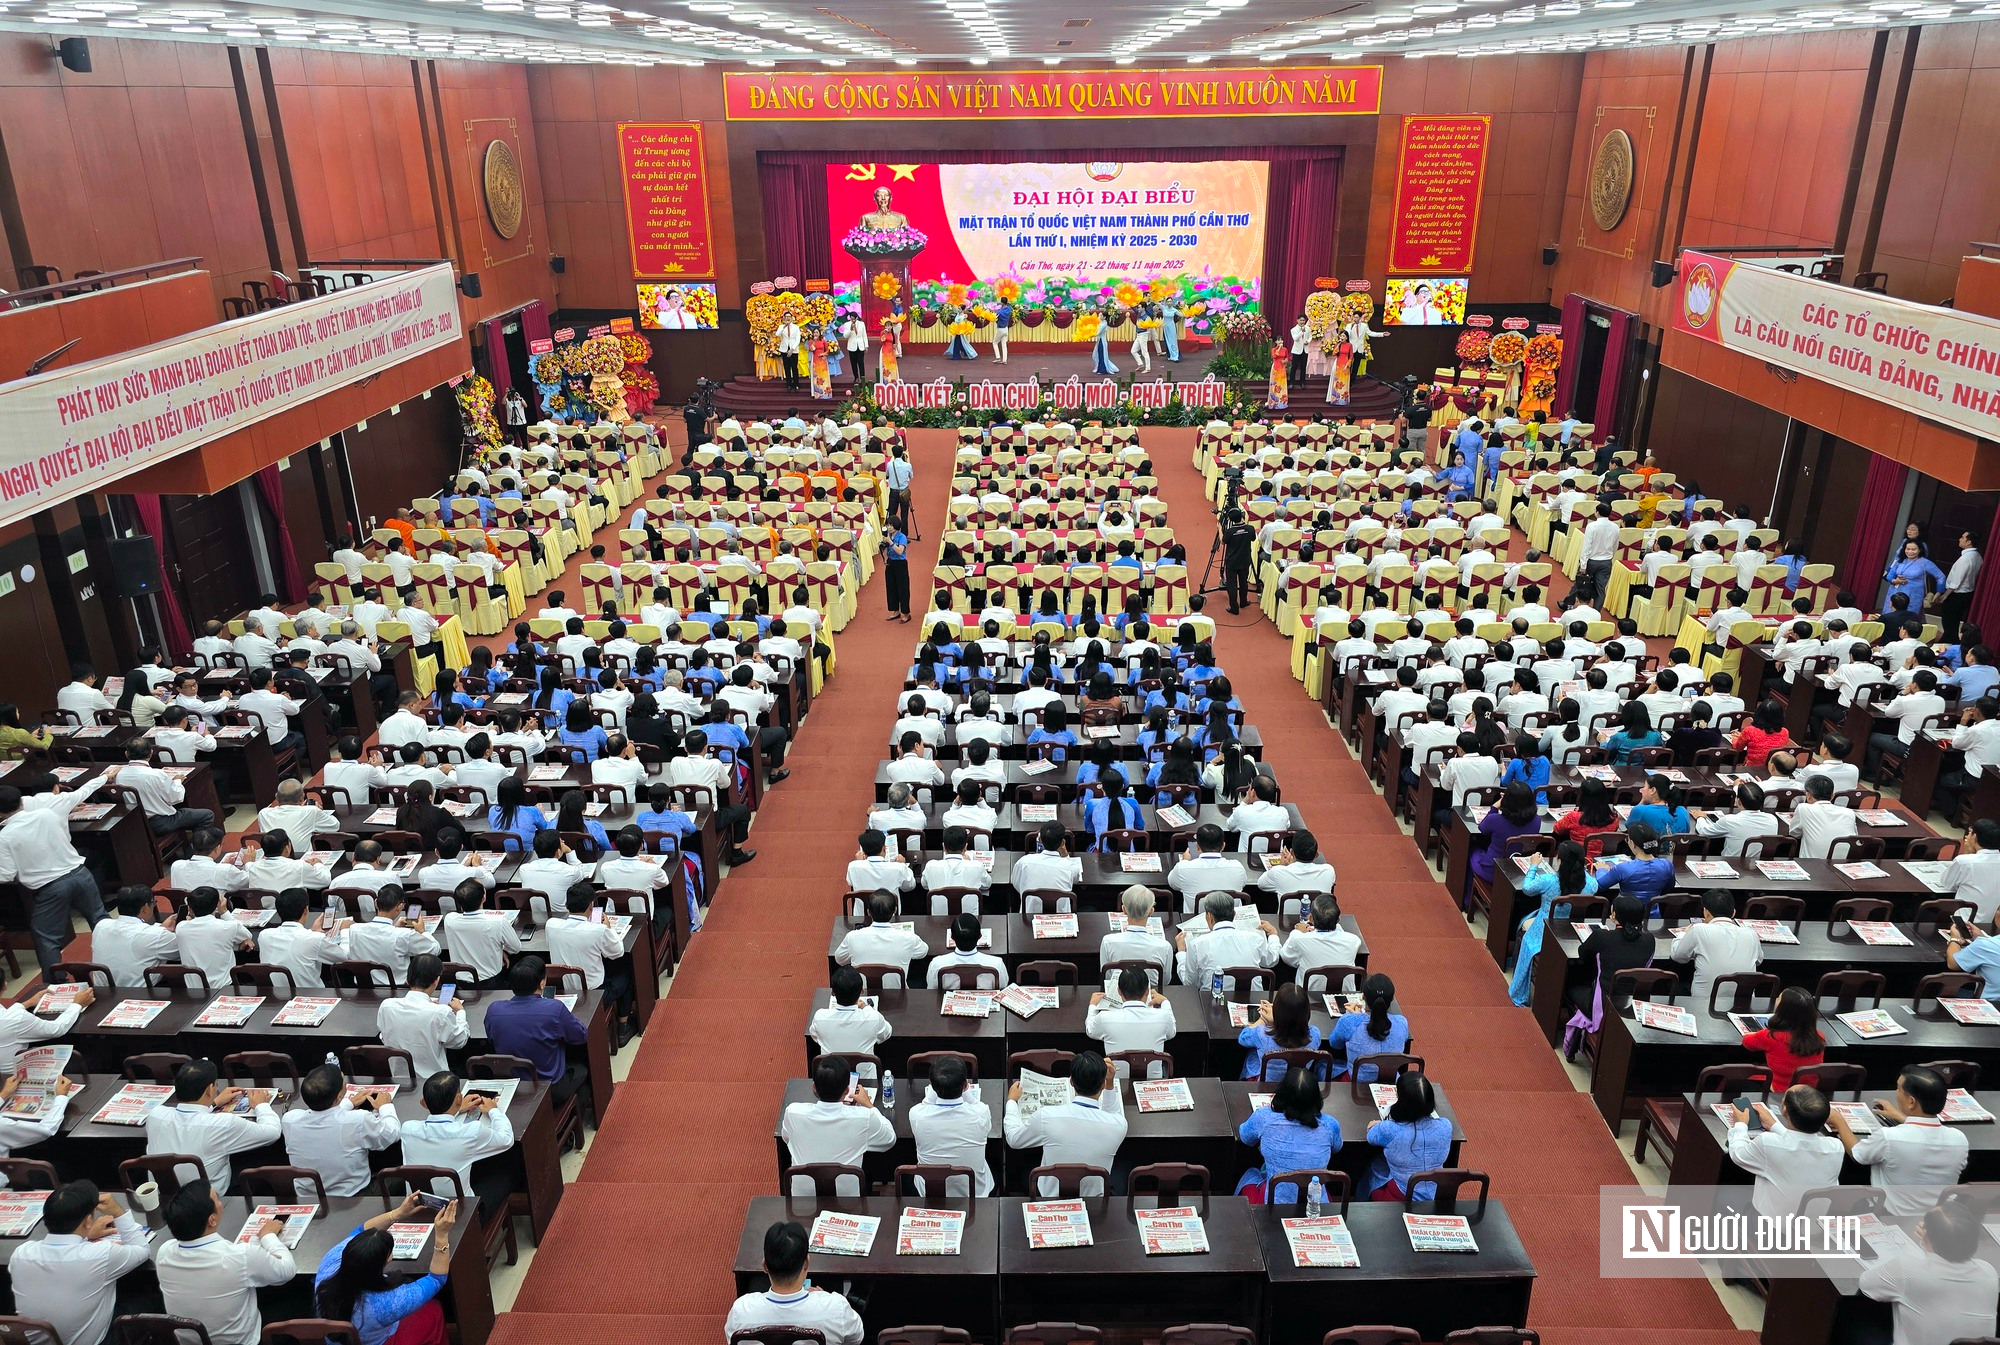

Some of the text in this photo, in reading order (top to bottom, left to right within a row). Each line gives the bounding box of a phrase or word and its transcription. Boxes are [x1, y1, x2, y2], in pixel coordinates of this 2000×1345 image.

[749, 73, 1357, 114] ĐẢNG CỘNG SẢN VIỆT NAM QUANG VINH MUÔN NĂM
[641, 134, 693, 144] Các đồng chí
[634, 147, 690, 156] từ Trung ương
[634, 159, 650, 167] đến
[667, 159, 680, 167] chi
[682, 159, 692, 168] bộ
[632, 171, 696, 181] cần phải giữ gìn
[676, 183, 688, 191] kết
[651, 195, 670, 203] nhất
[1013, 181, 1195, 208] ĐẠI HỘI ĐẠI BIỂU
[649, 207, 686, 216] của Đảng
[646, 219, 692, 228] như giữ gìn
[959, 211, 1250, 231] MẶT TRẬN TỔ QUỐC VIỆT NAM THÀNH PHỐ CẦN THƠ
[640, 242, 654, 250] của
[656, 242, 672, 250] mắt
[1009, 232, 1031, 248] LẦN
[1034, 234, 1058, 247] THỨ
[1060, 236, 1067, 248] I,
[1070, 233, 1108, 249] NHIỆM
[1112, 232, 1127, 246] KỲ
[1130, 235, 1158, 246] 2025
[1169, 234, 1198, 246] 2030
[1020, 260, 1036, 270] Cần
[1038, 261, 1054, 271] Thơ,
[1056, 262, 1075, 272] ngày
[1076, 261, 1088, 270] 21
[1094, 261, 1106, 270] 22
[1107, 260, 1130, 270] tháng
[1132, 261, 1142, 269] 11
[1162, 260, 1185, 269] 2025
[1802, 303, 1838, 330] CÁC
[1845, 310, 1871, 337] TỔ
[1873, 322, 1930, 355] CHỨC
[57, 287, 423, 426] PHÁT HUY SỨC MẠNH ĐẠI ĐOÀN KẾT TOÀN DÂN TỘC, QUYẾT TÂM THỰC HIỆN THẮNG LỢI
[1734, 315, 1752, 337] LÀ
[1757, 322, 1789, 349] CẦU
[1793, 333, 1823, 360] NỐI
[1828, 346, 1872, 376] GIỮA
[1879, 359, 1944, 402] ĐẢNG,
[875, 378, 918, 408] ĐOÀN
[923, 377, 952, 408] KẾT
[970, 379, 1003, 408] DÂN
[1008, 377, 1039, 408] CHỦ
[1055, 375, 1081, 408] ĐỔI
[1086, 379, 1116, 408] MỚI
[1133, 378, 1172, 407] PHÁT
[1178, 374, 1224, 407] TRIỂN
[0, 462, 41, 501] NGHỊ
[38, 438, 83, 487] QUYẾT
[84, 436, 109, 471] ĐẠI
[109, 424, 133, 461] HỘI
[132, 419, 155, 452] ĐẠI
[155, 401, 182, 441] BIỂU
[183, 397, 207, 432] MẶT
[208, 388, 236, 421] TRẬN
[235, 376, 249, 410] TỔ
[250, 370, 274, 406] QUỐC
[274, 366, 294, 397] VIỆT
[294, 361, 314, 388] NAM
[314, 358, 327, 380] TP.
[327, 346, 343, 375] CẦN
[343, 344, 358, 369] THƠ
[358, 335, 372, 363] LẦN
[372, 332, 385, 357] THỨ
[391, 324, 412, 351] NHIỆM
[412, 320, 421, 342] KỲ
[421, 318, 435, 339] 2025
[438, 312, 452, 333] 2030
